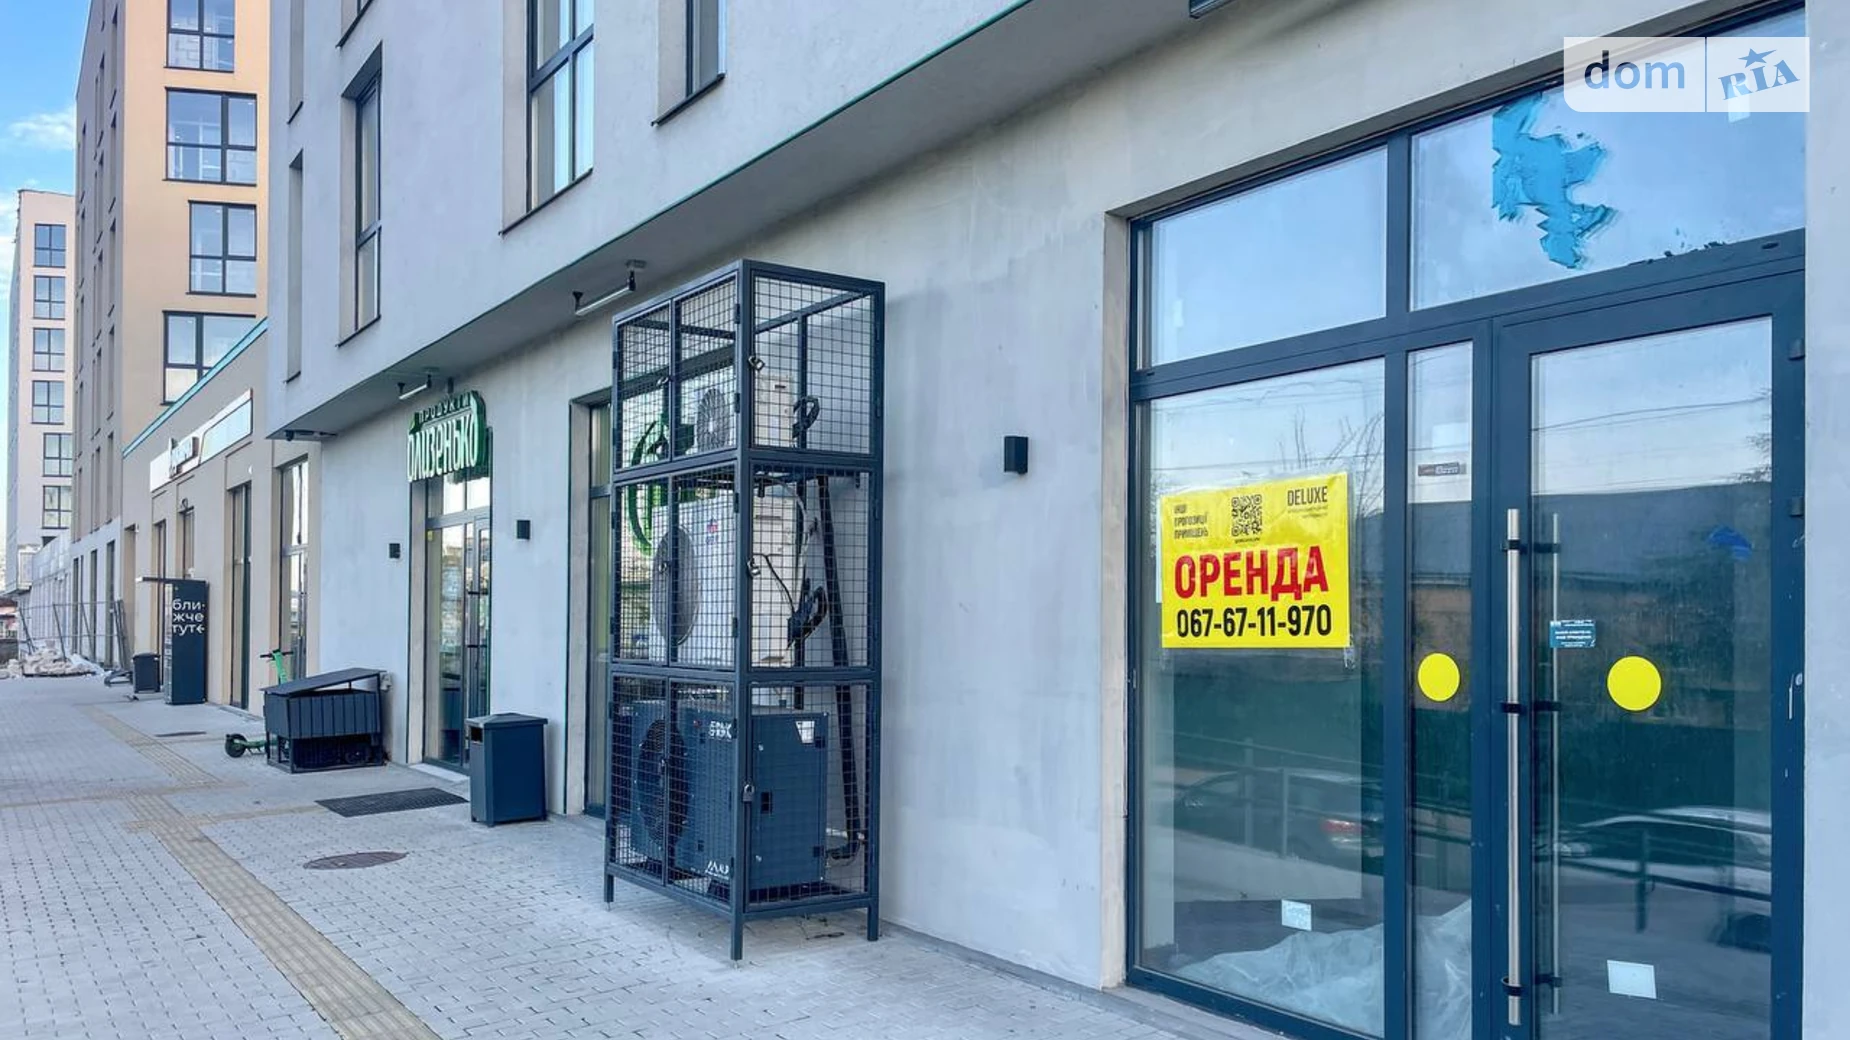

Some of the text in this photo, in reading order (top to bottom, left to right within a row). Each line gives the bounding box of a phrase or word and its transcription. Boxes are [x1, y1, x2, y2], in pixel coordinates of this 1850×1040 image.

[1287, 485, 1328, 507] DELUXE
[1174, 545, 1329, 601] ОРЕНДА
[1176, 604, 1332, 638] 067-67-11-970
